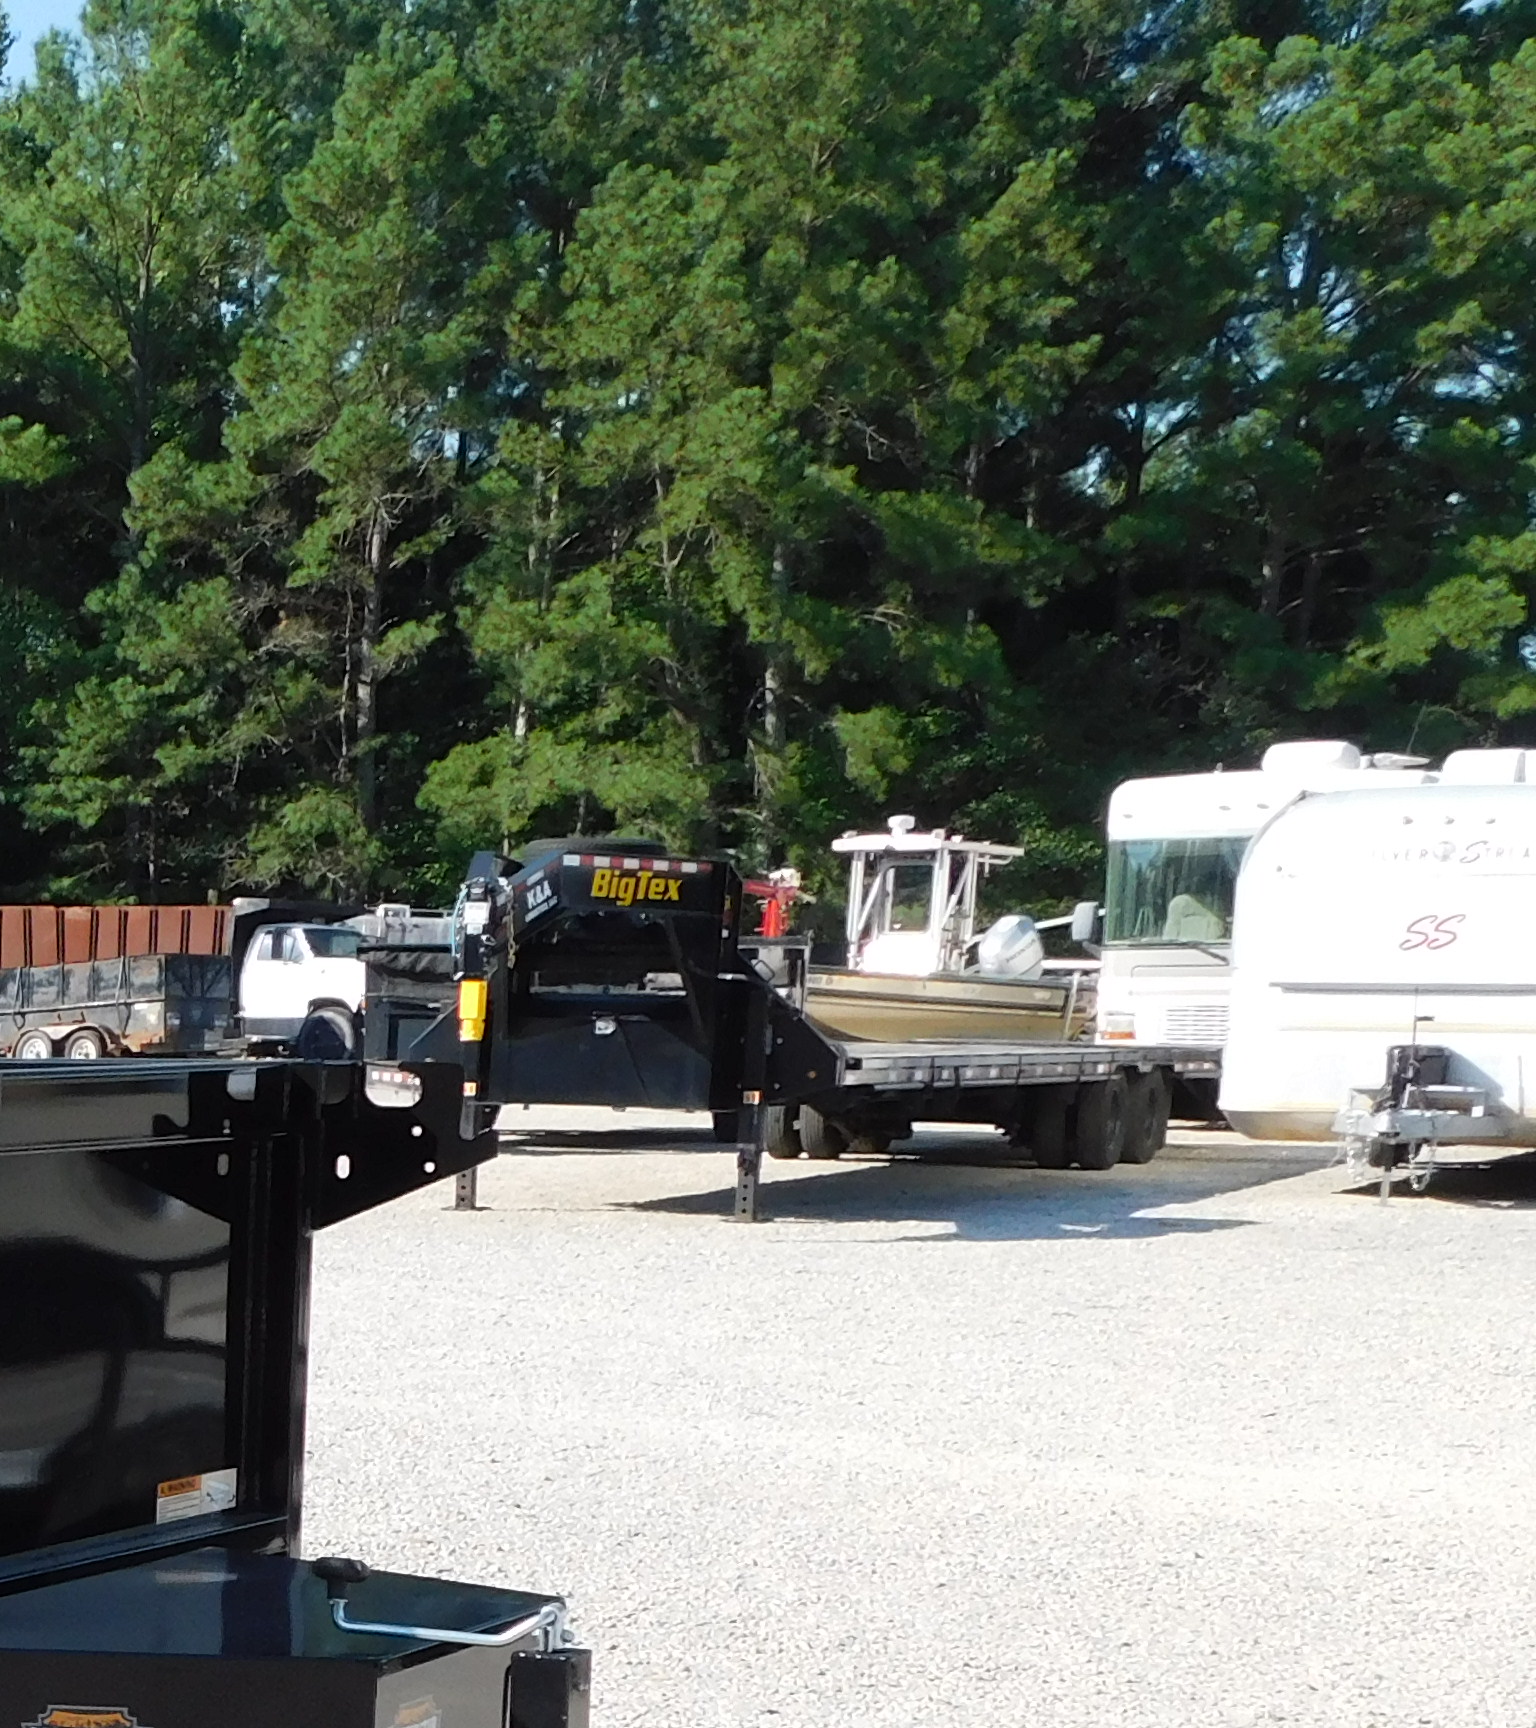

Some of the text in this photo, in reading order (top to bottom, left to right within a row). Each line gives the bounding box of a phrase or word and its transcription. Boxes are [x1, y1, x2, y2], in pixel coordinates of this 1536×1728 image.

[526, 879, 553, 910] K&A
[591, 868, 683, 907] BigTex
[1398, 912, 1467, 951] SS
